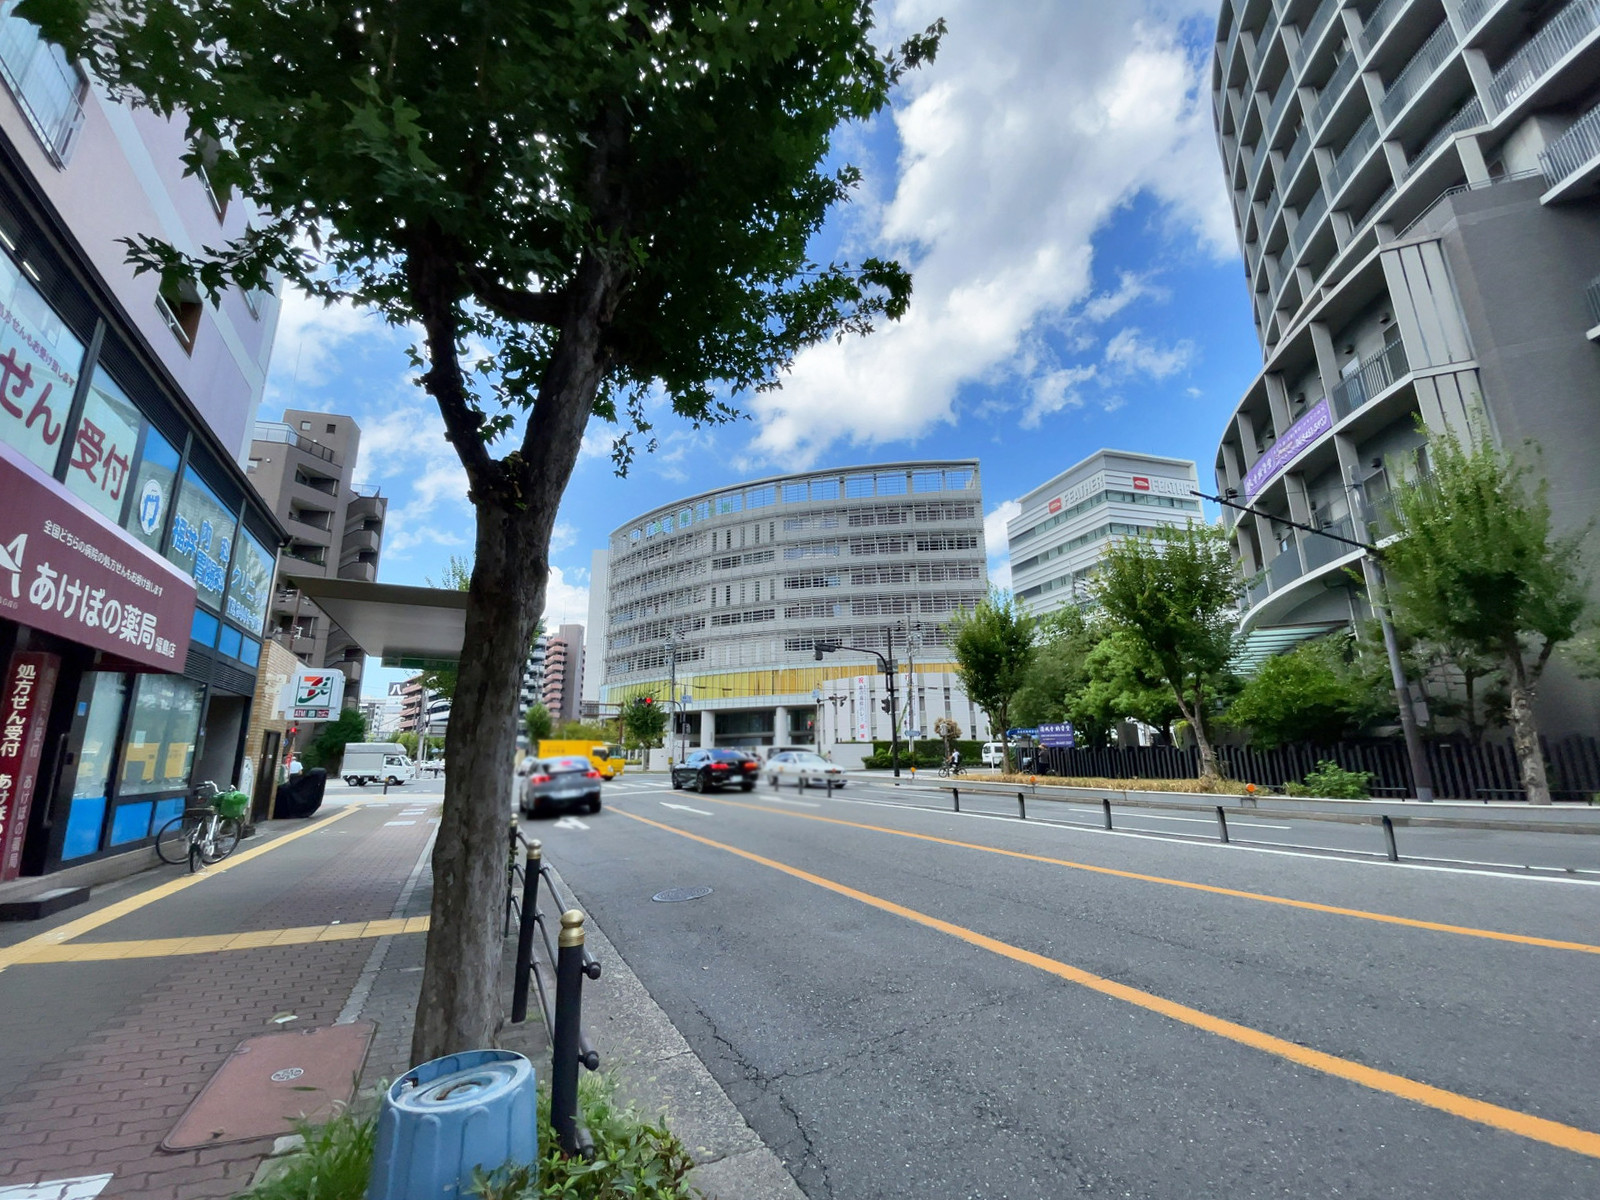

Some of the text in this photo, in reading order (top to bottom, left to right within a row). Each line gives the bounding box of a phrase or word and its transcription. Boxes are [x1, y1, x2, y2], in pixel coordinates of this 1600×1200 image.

[29, 561, 177, 659] あけぼの薬局 福島店
[0, 663, 36, 757] 処方せん受付
